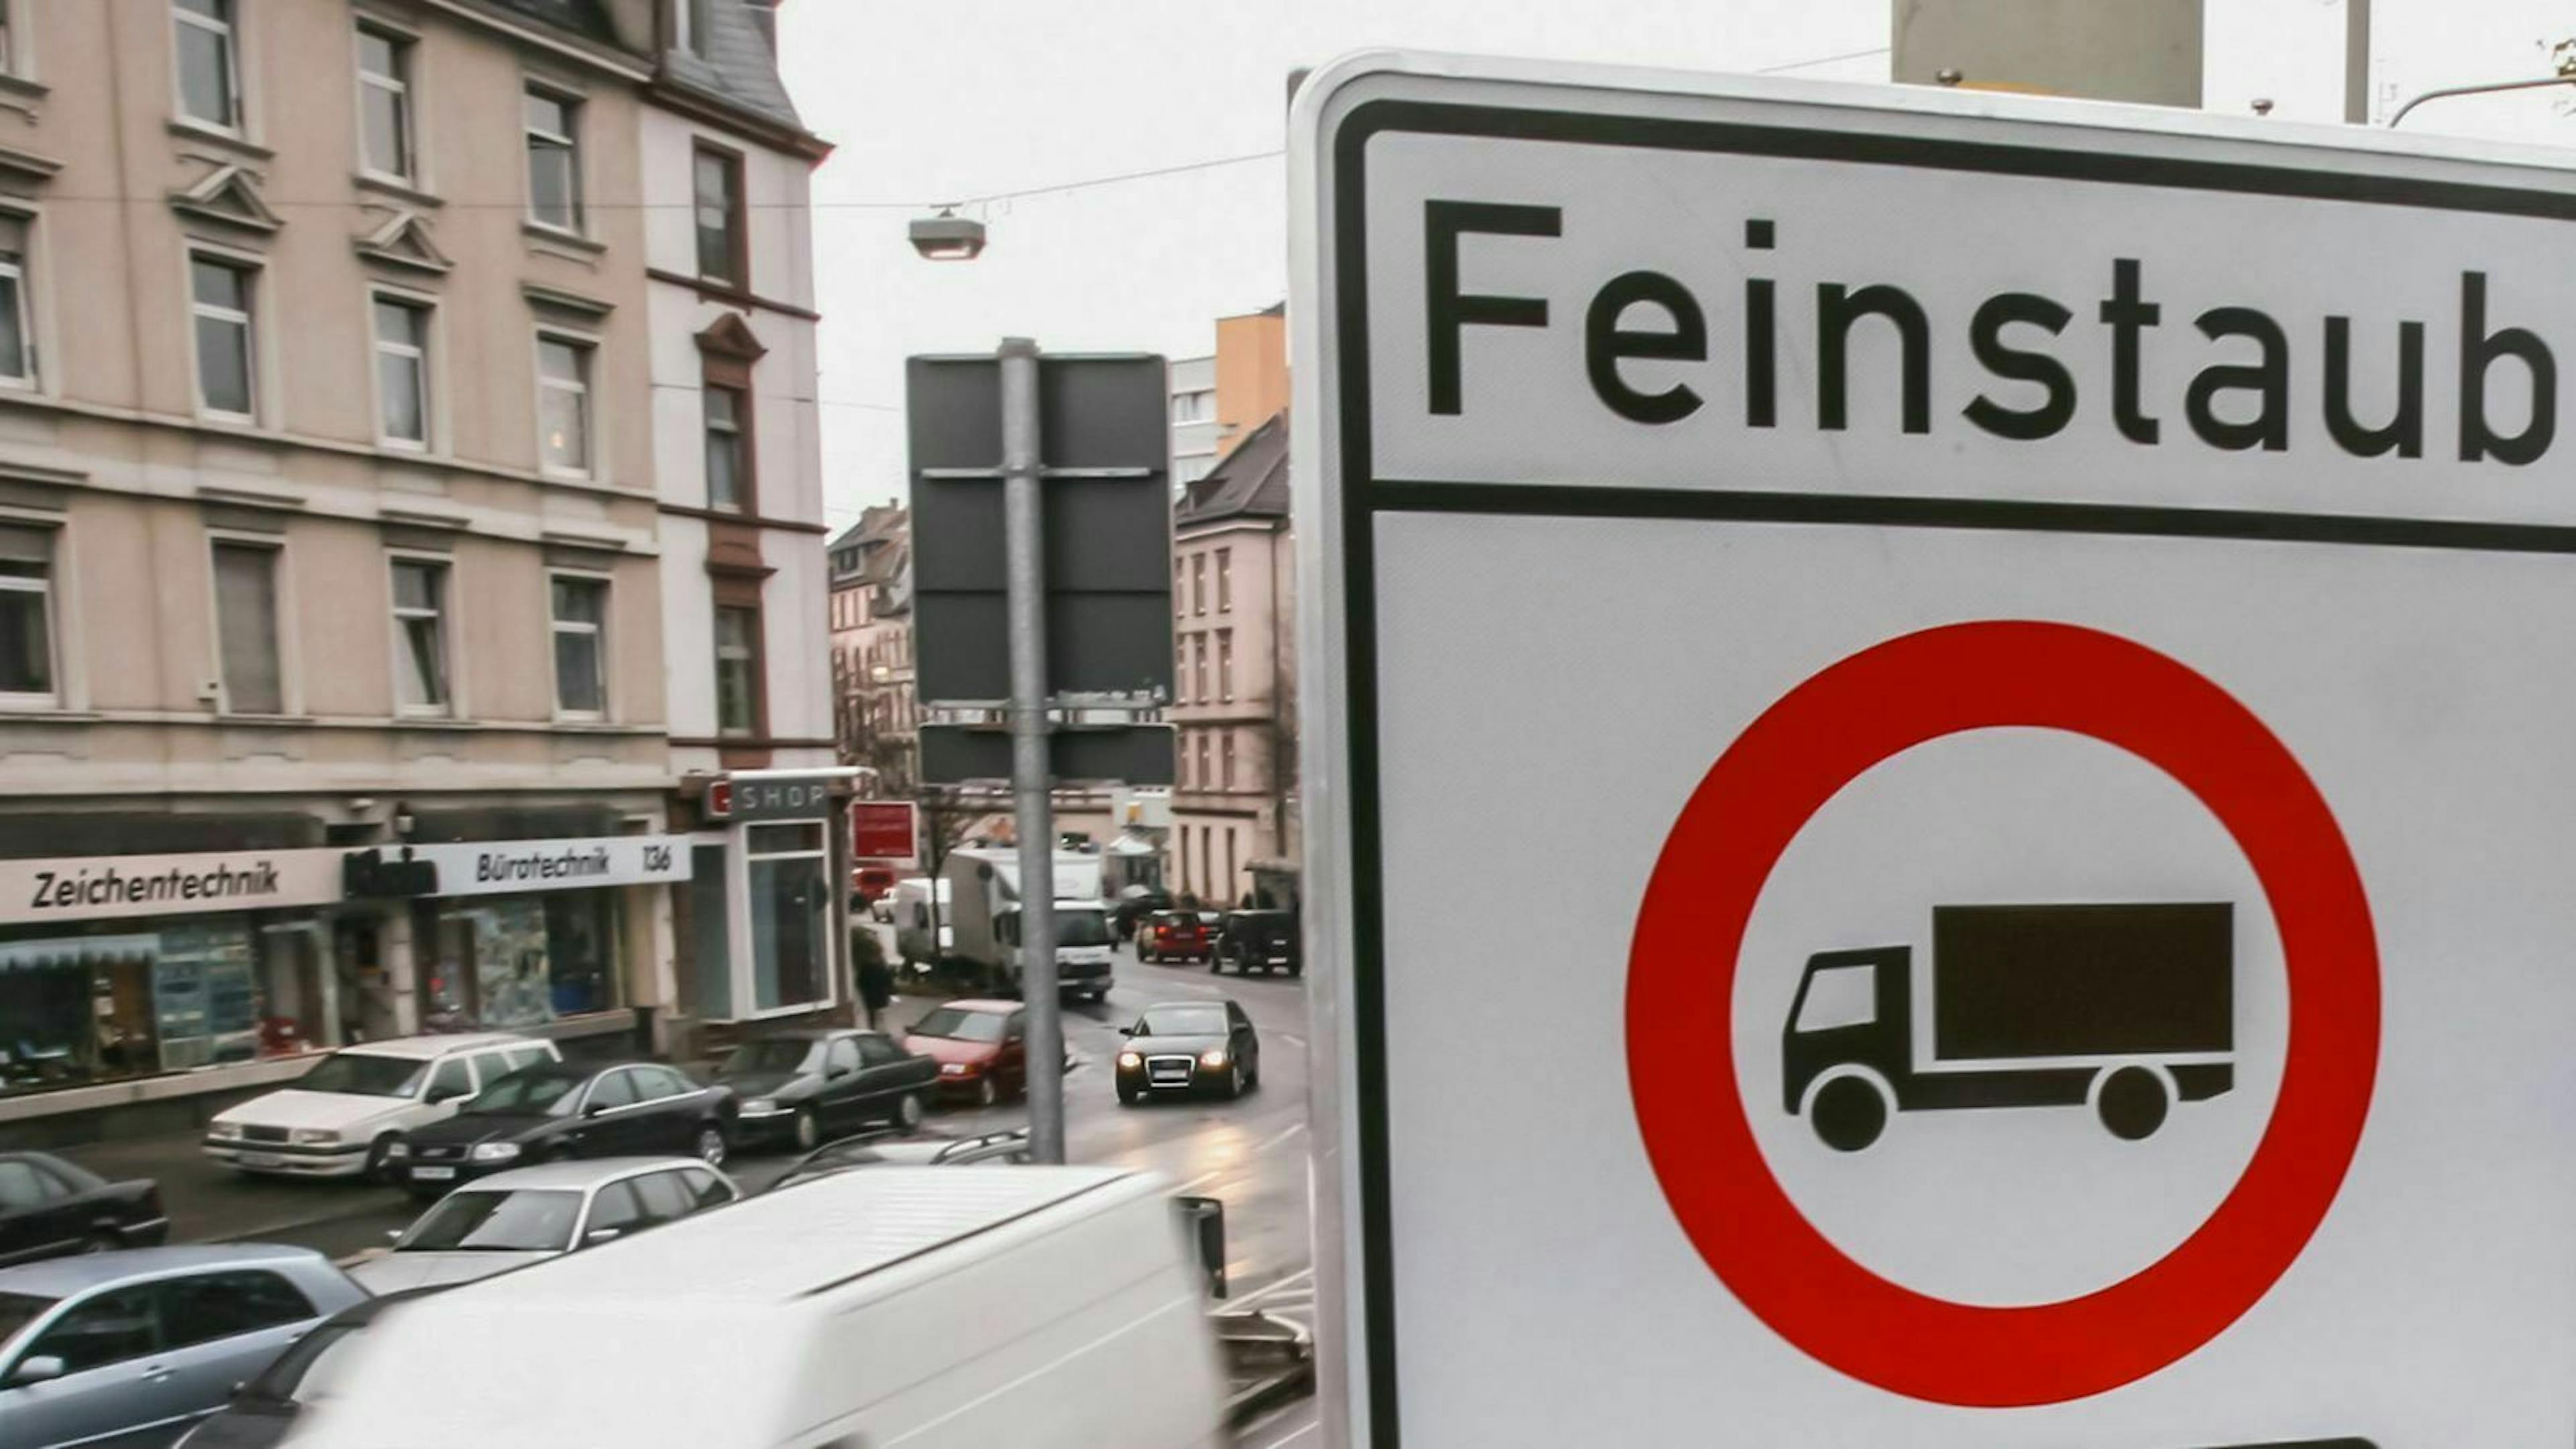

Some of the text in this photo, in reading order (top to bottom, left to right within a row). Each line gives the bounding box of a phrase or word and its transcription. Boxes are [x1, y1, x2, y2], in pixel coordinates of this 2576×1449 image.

[1424, 198, 2558, 467] Feinstaub
[741, 785, 826, 809] SHOP
[32, 860, 280, 908] Zeichentechnik
[477, 845, 672, 883] Bürotechnik 136
